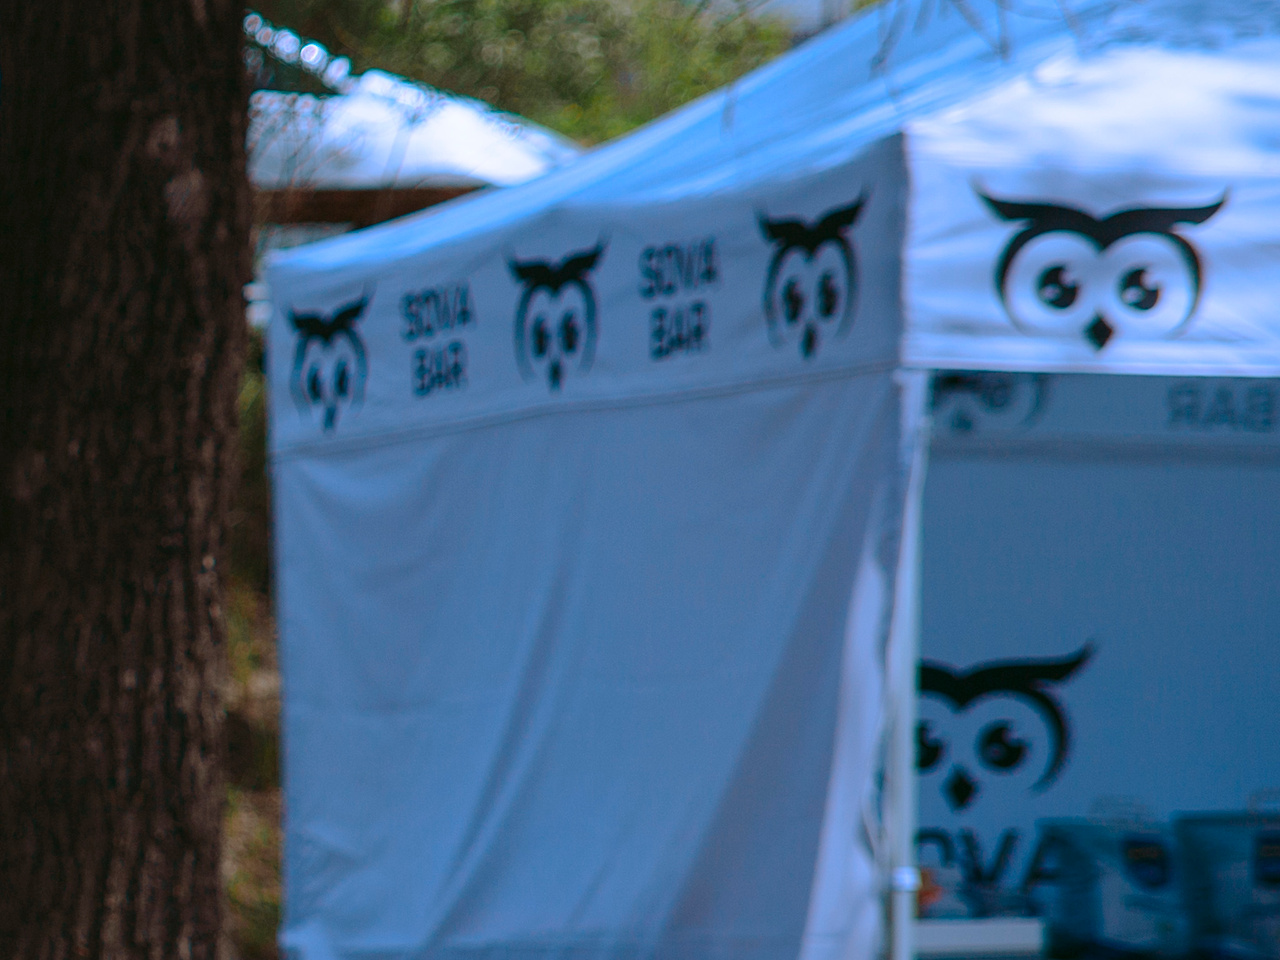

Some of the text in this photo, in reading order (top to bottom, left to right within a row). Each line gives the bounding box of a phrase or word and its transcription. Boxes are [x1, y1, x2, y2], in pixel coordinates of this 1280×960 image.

[638, 239, 718, 299] SOVA
[402, 282, 474, 341] SOVA
[650, 302, 711, 361] BAR
[413, 341, 468, 396] BAR
